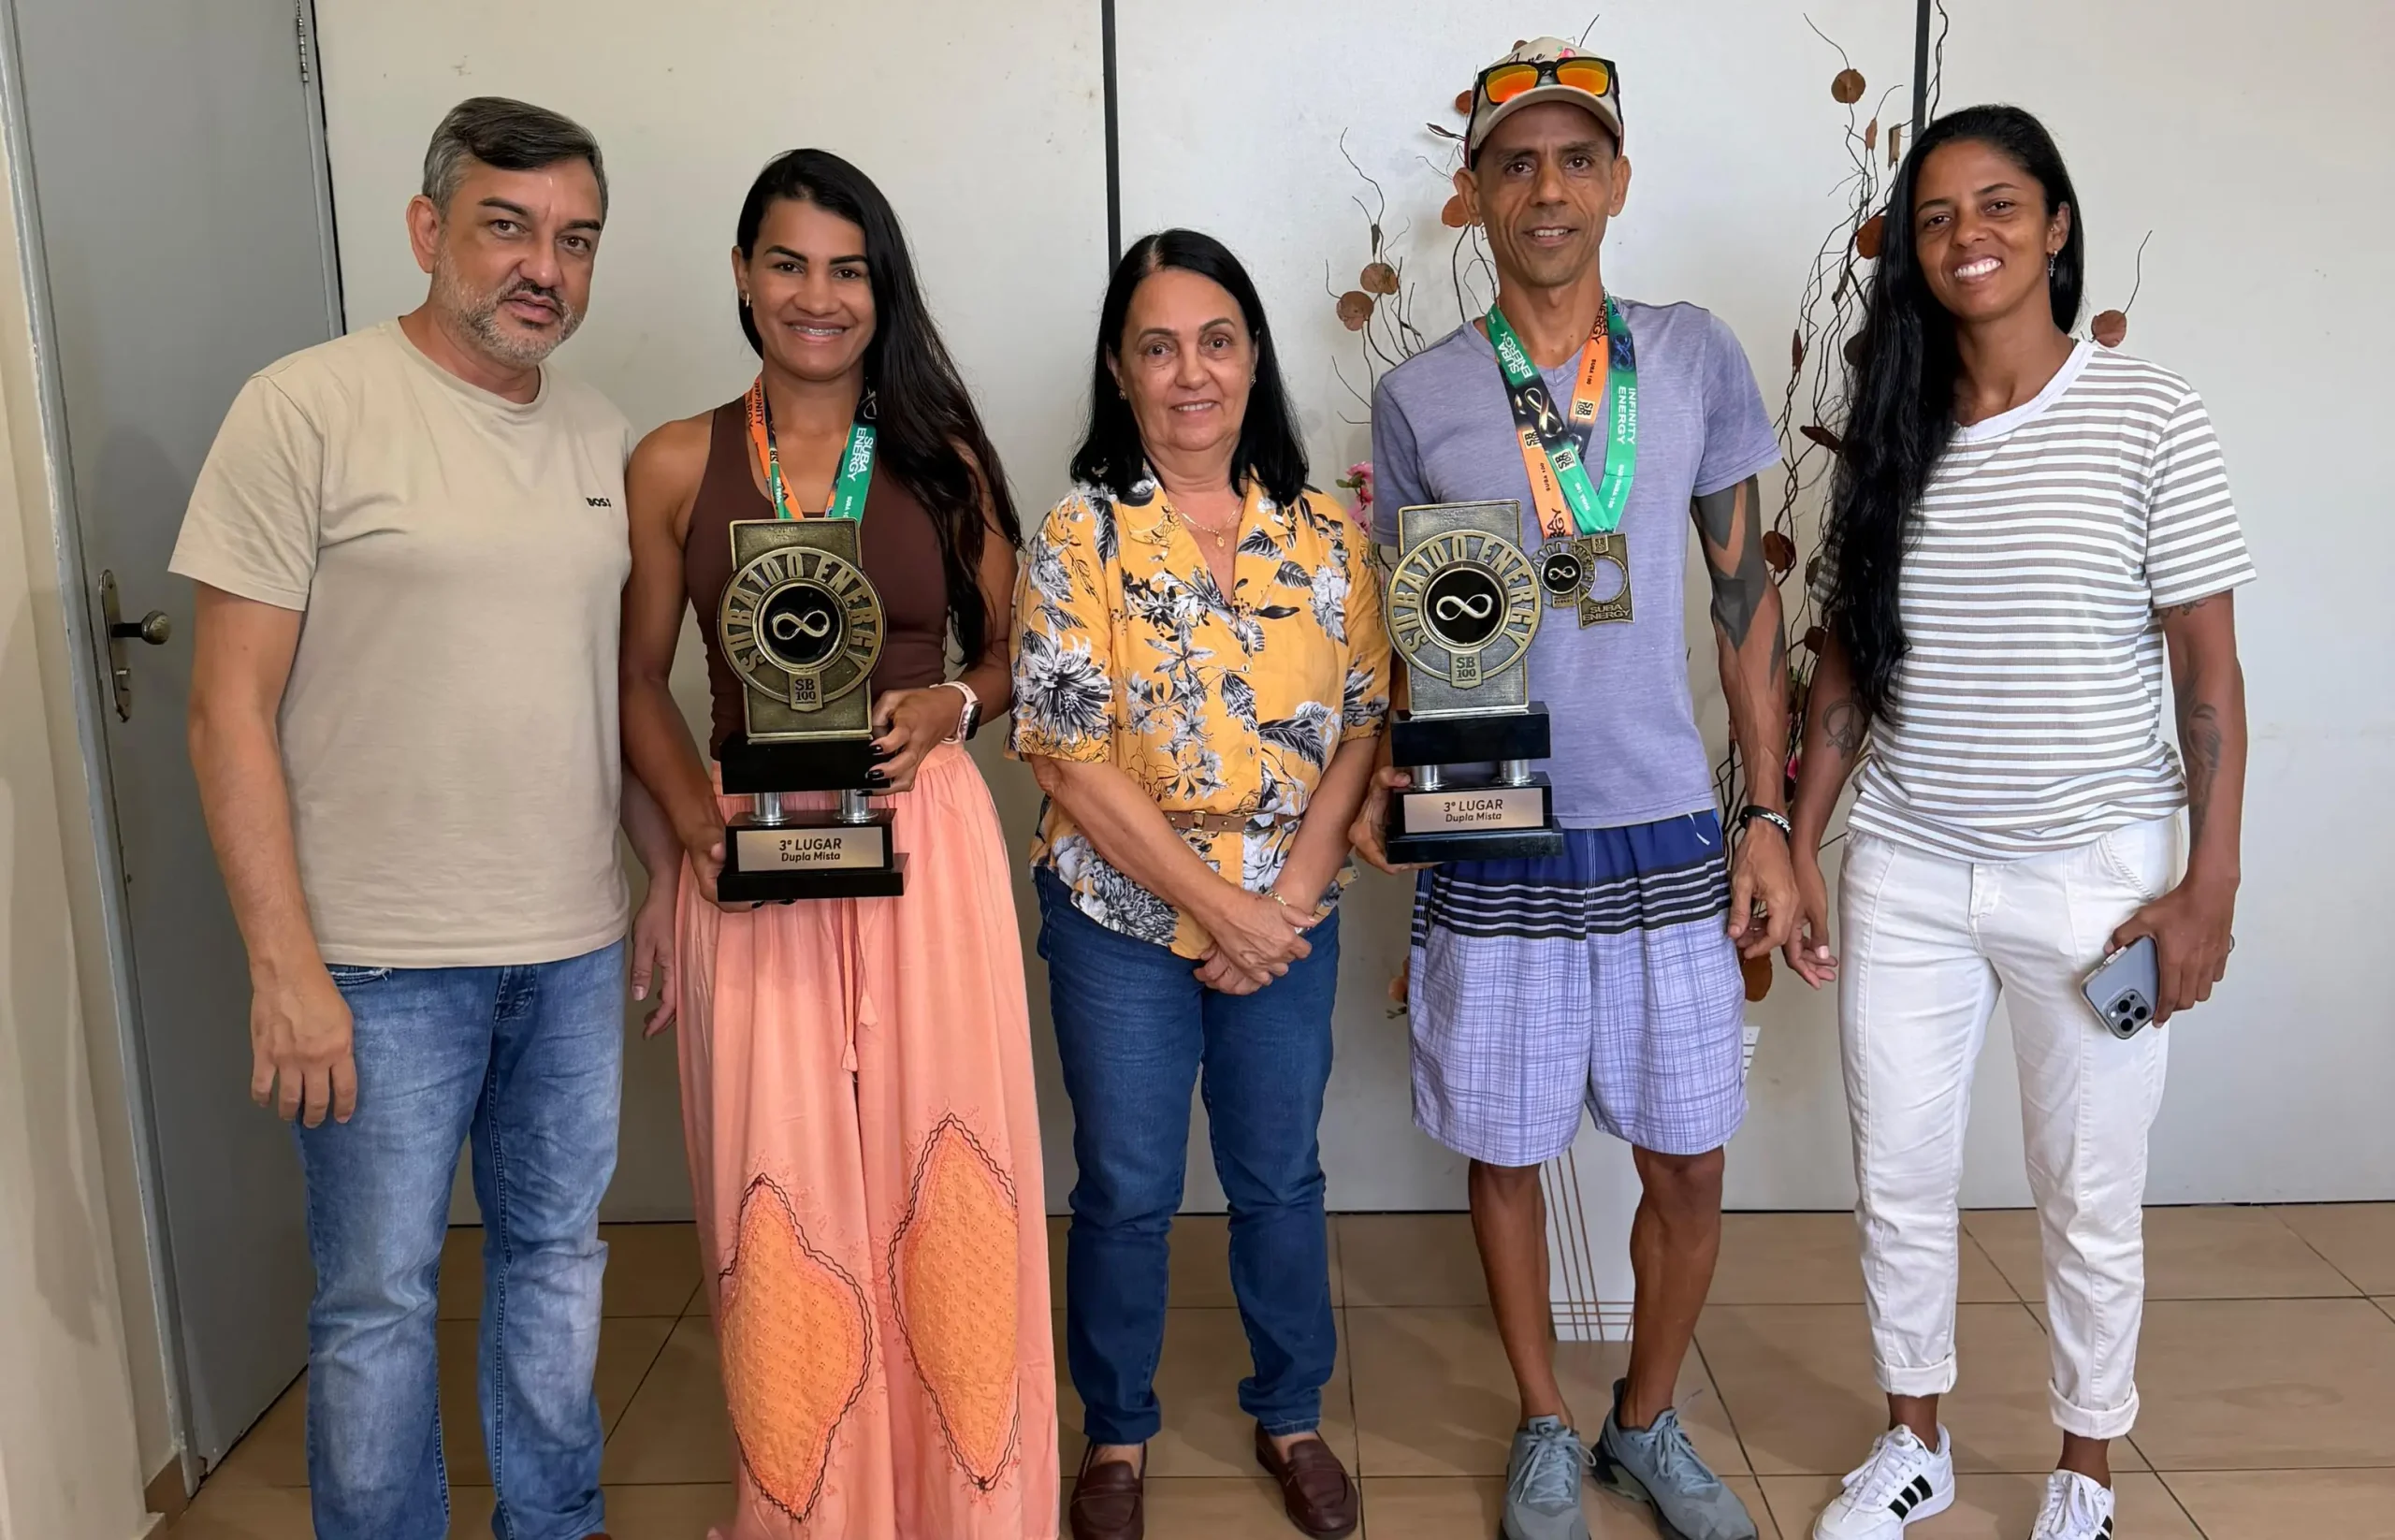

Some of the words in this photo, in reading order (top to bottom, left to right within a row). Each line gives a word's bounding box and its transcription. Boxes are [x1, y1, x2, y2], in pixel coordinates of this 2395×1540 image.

[1498, 341, 1520, 374] SUBA
[1500, 331, 1533, 379] ENERGY
[1617, 385, 1627, 444] ENERGY
[1627, 387, 1636, 444] INFINITY
[848, 427, 867, 482] ENERGY
[857, 436, 874, 473] SUBA
[1476, 536, 1535, 647] ENERGY
[813, 554, 877, 669] ENERGY
[1590, 603, 1622, 614] SUBA
[1582, 609, 1631, 621] ENERGY
[1456, 657, 1475, 669] SB
[1456, 669, 1476, 677] 100
[795, 679, 815, 690] SB
[795, 690, 817, 701] 100
[1459, 799, 1503, 811] LUGAR
[1445, 812, 1473, 823] Dupla
[1476, 811, 1502, 821] Mista
[795, 838, 841, 850] LUGAR
[781, 852, 811, 863] Dupla
[814, 851, 841, 861] Mista
